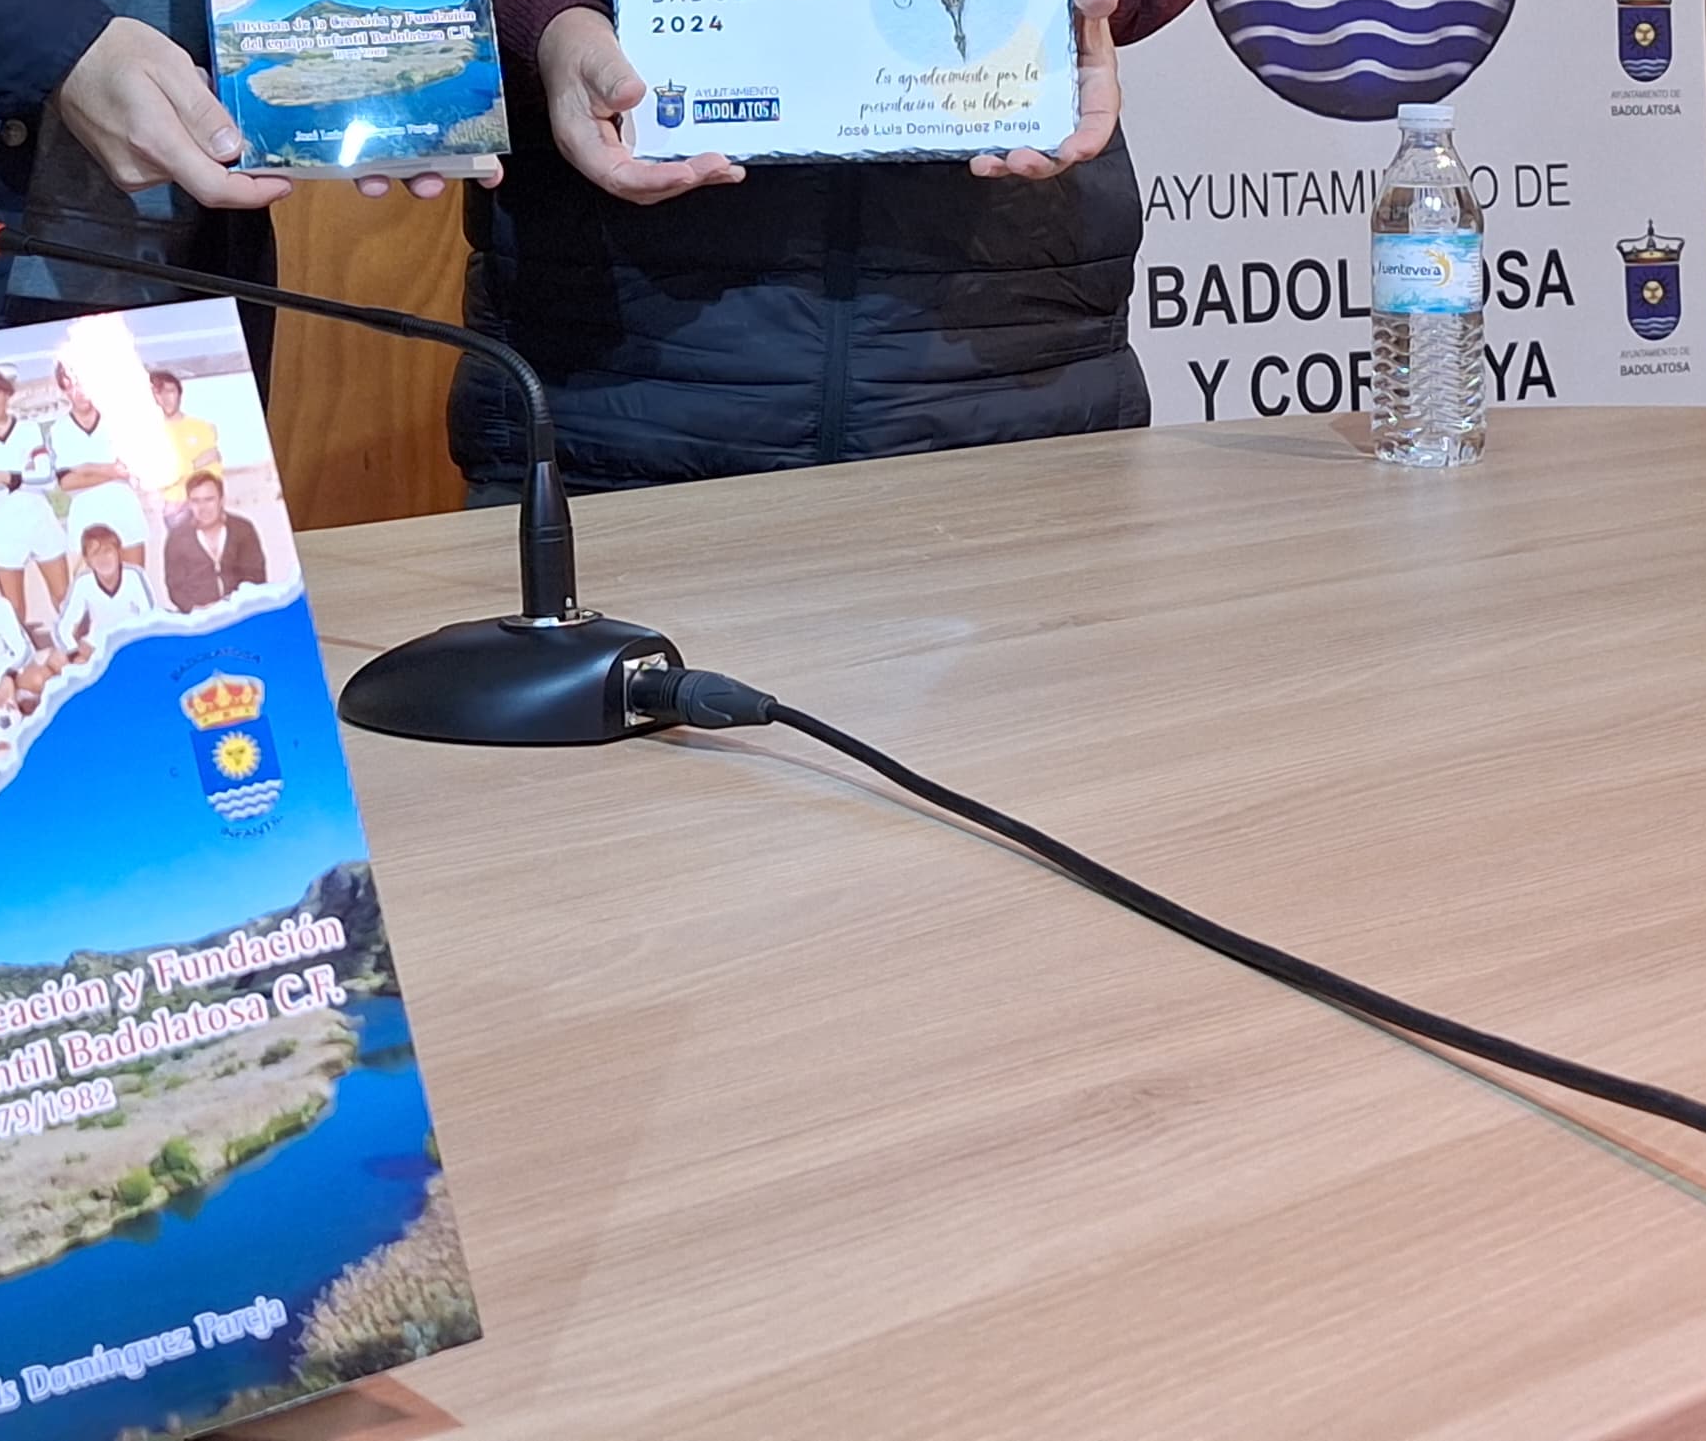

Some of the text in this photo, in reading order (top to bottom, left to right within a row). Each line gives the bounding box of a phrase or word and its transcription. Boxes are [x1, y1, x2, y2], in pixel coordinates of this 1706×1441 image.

[652, 15, 723, 34] 2024
[996, 72, 1018, 89] por
[1025, 63, 1039, 82] la
[694, 101, 780, 121] BADOLATOSA
[941, 93, 957, 111] de
[962, 100, 977, 112] su
[983, 91, 1014, 111] libro
[1611, 104, 1682, 116] BADOLATOSA
[837, 123, 870, 137] José
[873, 123, 902, 136] Luis
[994, 119, 1040, 134] Pareja
[1144, 163, 1572, 221] AYUNTAMIO DE
[1146, 248, 1575, 329] BADOLSA
[1620, 362, 1691, 377] BADOLATOSA
[1188, 358, 1230, 422] Y
[115, 969, 144, 1008] y
[151, 915, 343, 990] Fundación
[63, 994, 267, 1073] Badolatosa
[273, 965, 344, 1014] C.F.
[194, 1294, 289, 1350] Pareja
